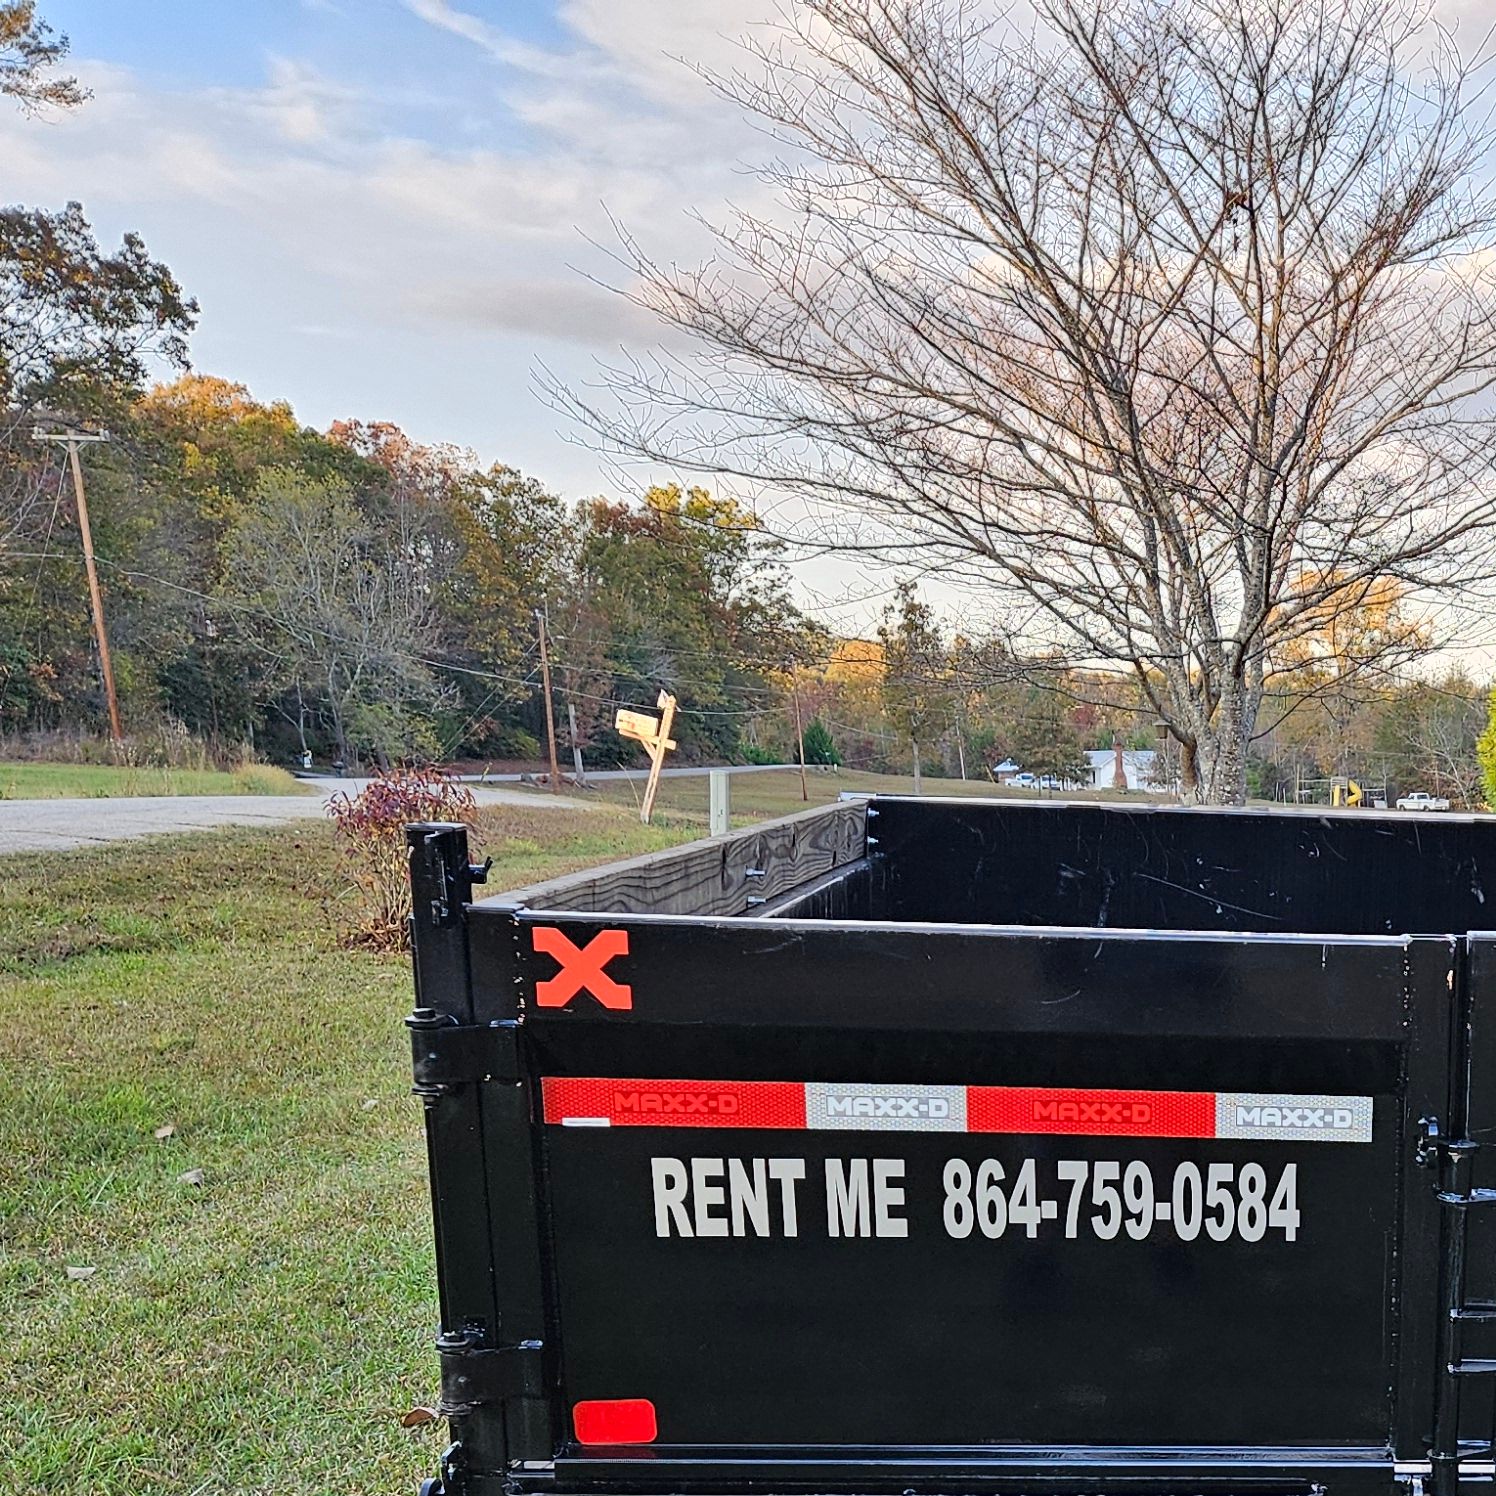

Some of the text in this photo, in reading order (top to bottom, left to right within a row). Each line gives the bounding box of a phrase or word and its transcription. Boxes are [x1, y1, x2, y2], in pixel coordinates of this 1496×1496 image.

[614, 1092, 1353, 1128] MAXX-D MAXX-D MAXX-D MAXX-D
[651, 1157, 1300, 1242] RENT ME 864-759-0584
